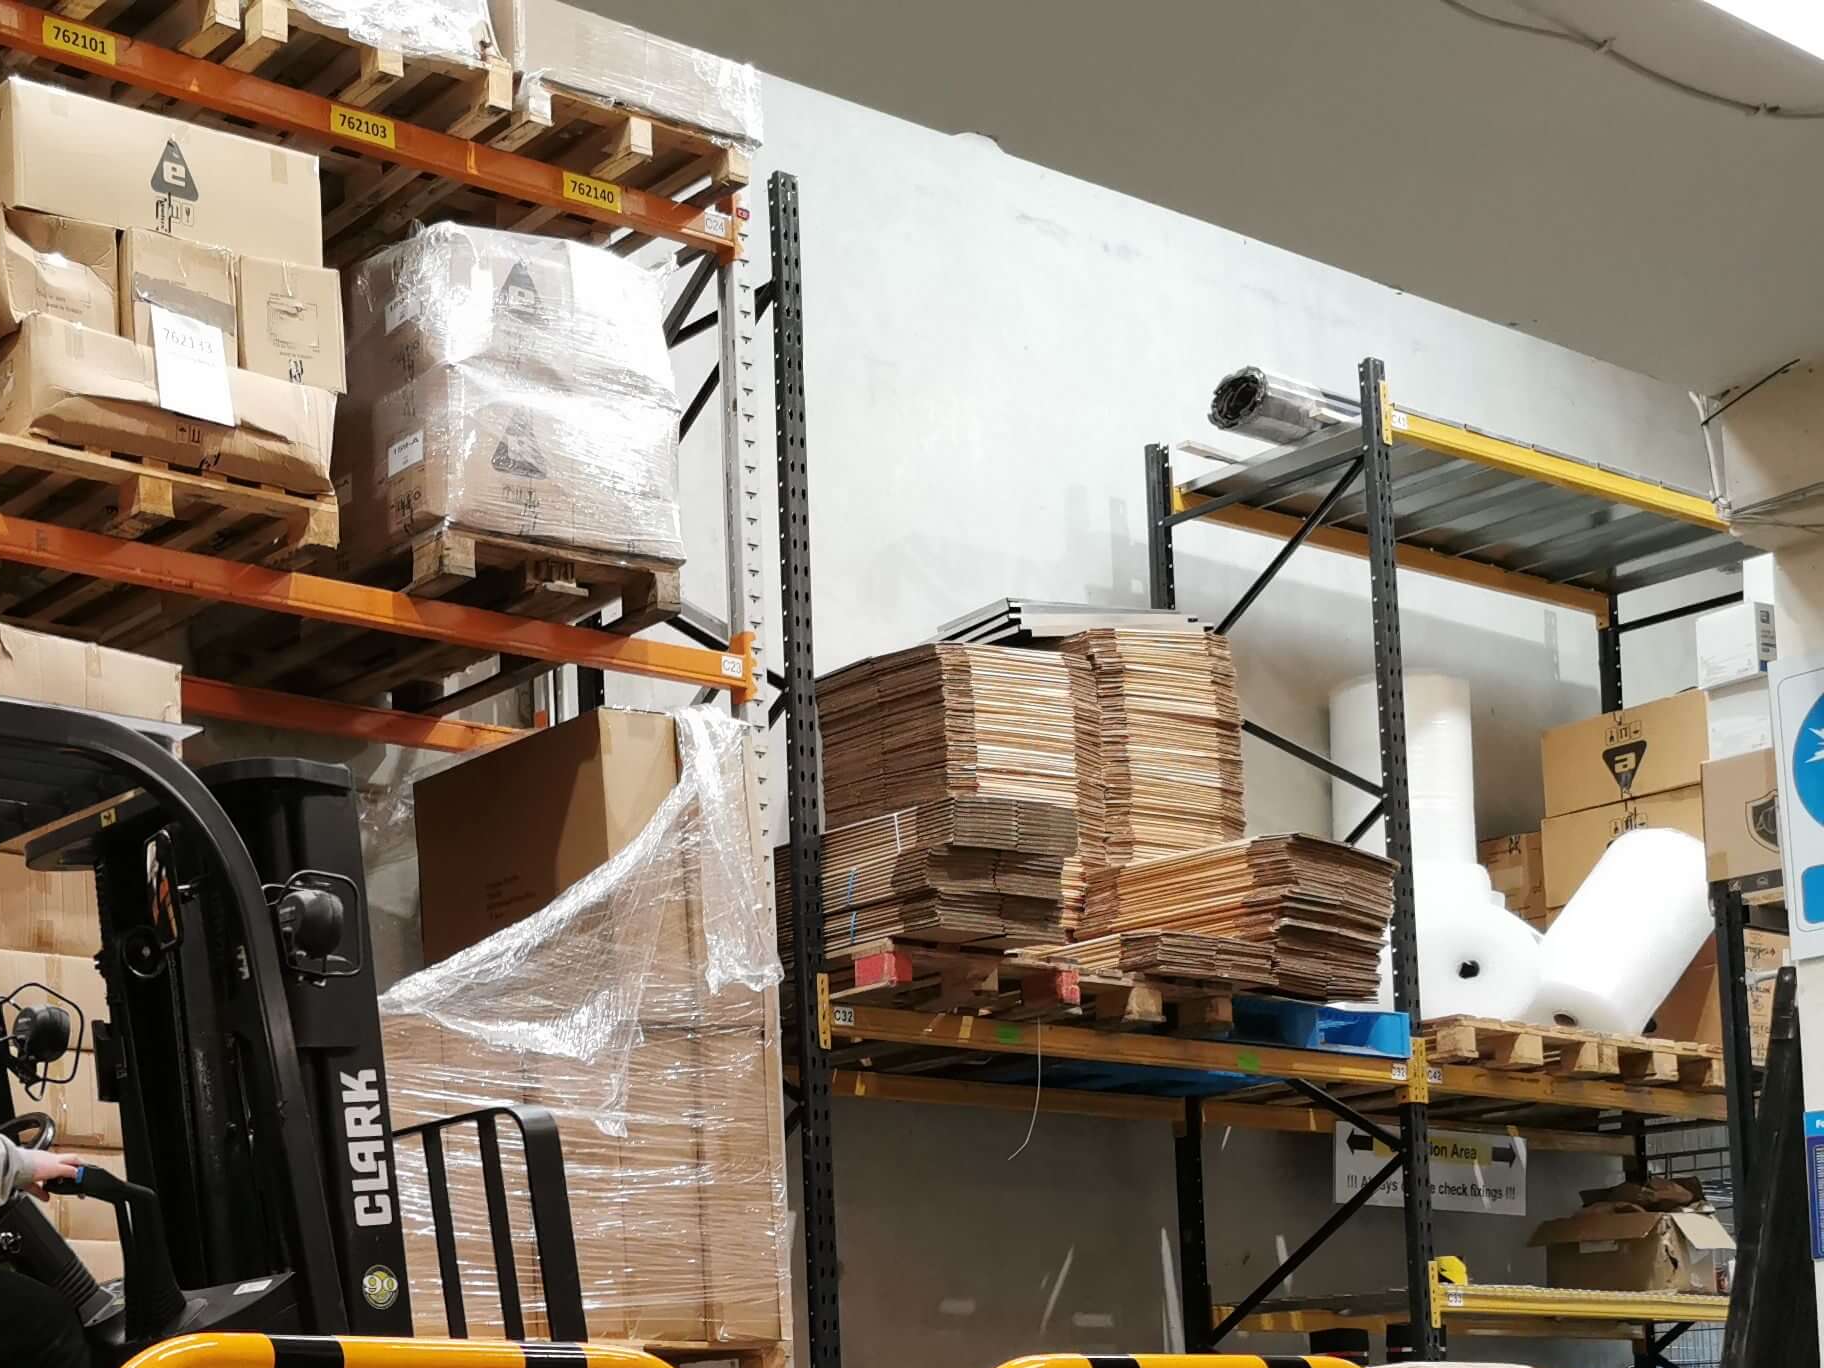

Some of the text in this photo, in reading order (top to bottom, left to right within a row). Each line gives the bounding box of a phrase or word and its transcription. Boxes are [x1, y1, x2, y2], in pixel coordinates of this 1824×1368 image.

[52, 25, 107, 55] 762101
[338, 113, 387, 139] 762103
[569, 179, 615, 204] 762140
[705, 216, 726, 234] C24
[834, 1009, 853, 1023] C32
[339, 1068, 393, 1227] CLARK
[1450, 1143, 1477, 1160] Area
[1438, 1182, 1469, 1197] check
[1470, 1184, 1503, 1202] fixings
